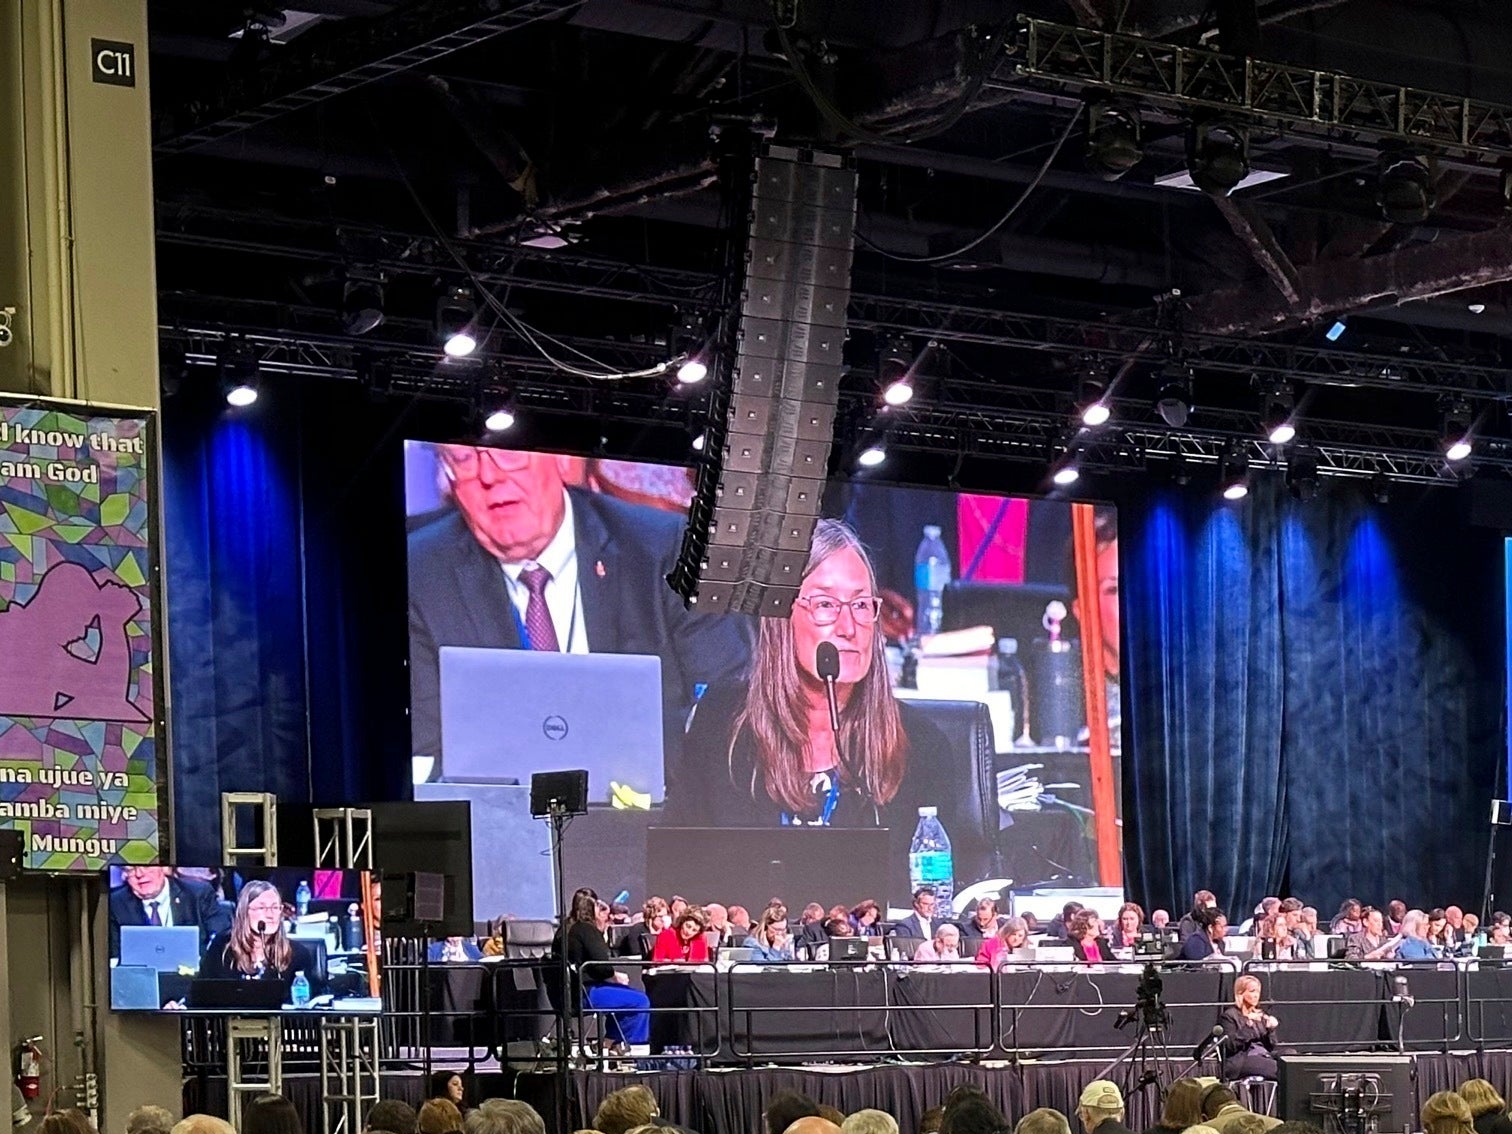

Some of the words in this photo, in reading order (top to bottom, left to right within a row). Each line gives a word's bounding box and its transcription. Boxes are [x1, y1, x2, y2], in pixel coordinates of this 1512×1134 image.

[96, 50, 131, 77] C11
[15, 423, 84, 448] know
[90, 432, 144, 454] that
[1, 462, 41, 479] am
[47, 462, 98, 484] God
[38, 766, 93, 788] ujue
[98, 771, 129, 790] ya
[76, 801, 138, 824] miye
[32, 834, 116, 858] Mungu
